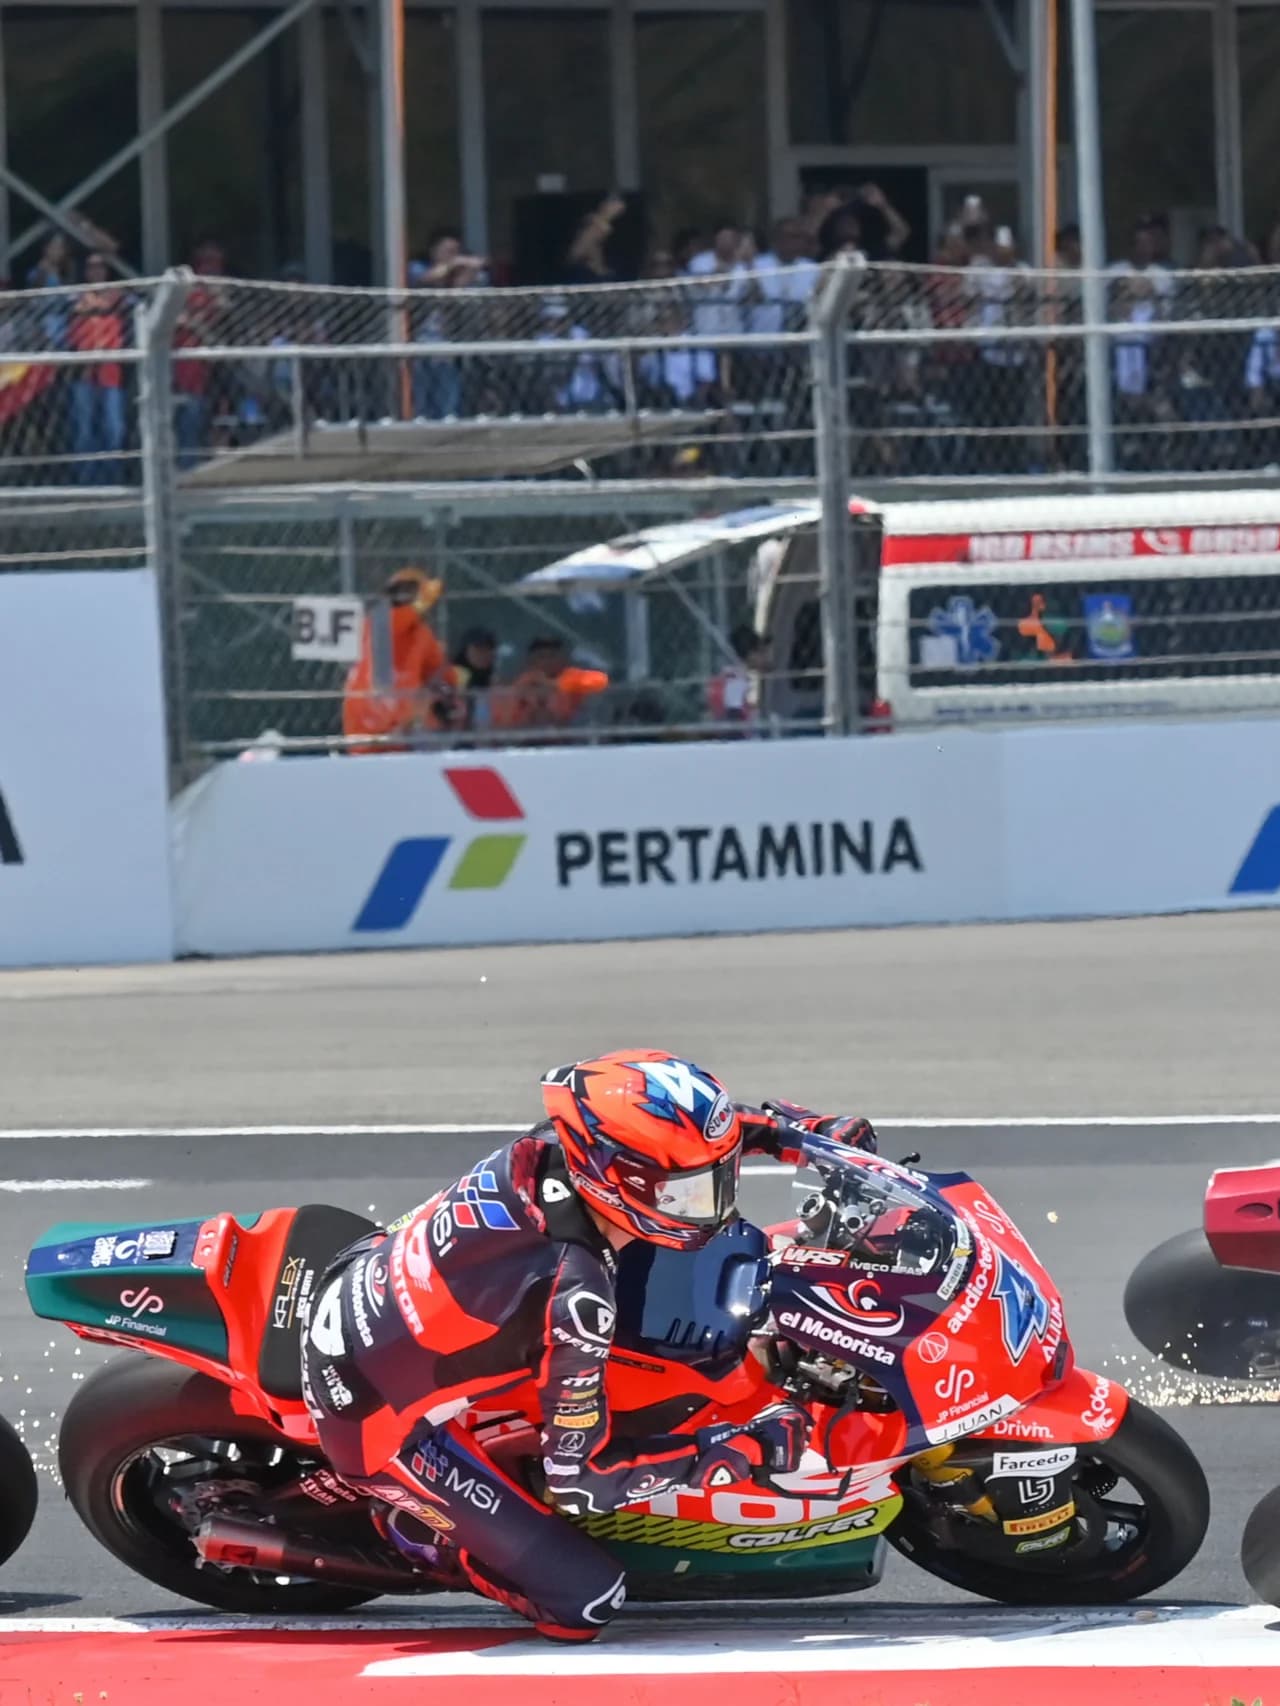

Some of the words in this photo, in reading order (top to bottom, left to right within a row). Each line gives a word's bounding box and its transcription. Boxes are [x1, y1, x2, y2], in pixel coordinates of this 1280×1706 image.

[555, 816, 925, 889] PERTAMINA
[783, 1247, 847, 1266] WRS
[850, 1259, 890, 1273] IVECO
[105, 1314, 121, 1325] JP
[121, 1317, 167, 1336] Financial
[779, 1311, 802, 1333] el
[803, 1317, 896, 1366] Motorista
[936, 1408, 949, 1424] JP
[950, 1392, 990, 1416] Financial
[1000, 1453, 1070, 1470] Farcedo
[729, 1508, 878, 1548] GALFER
